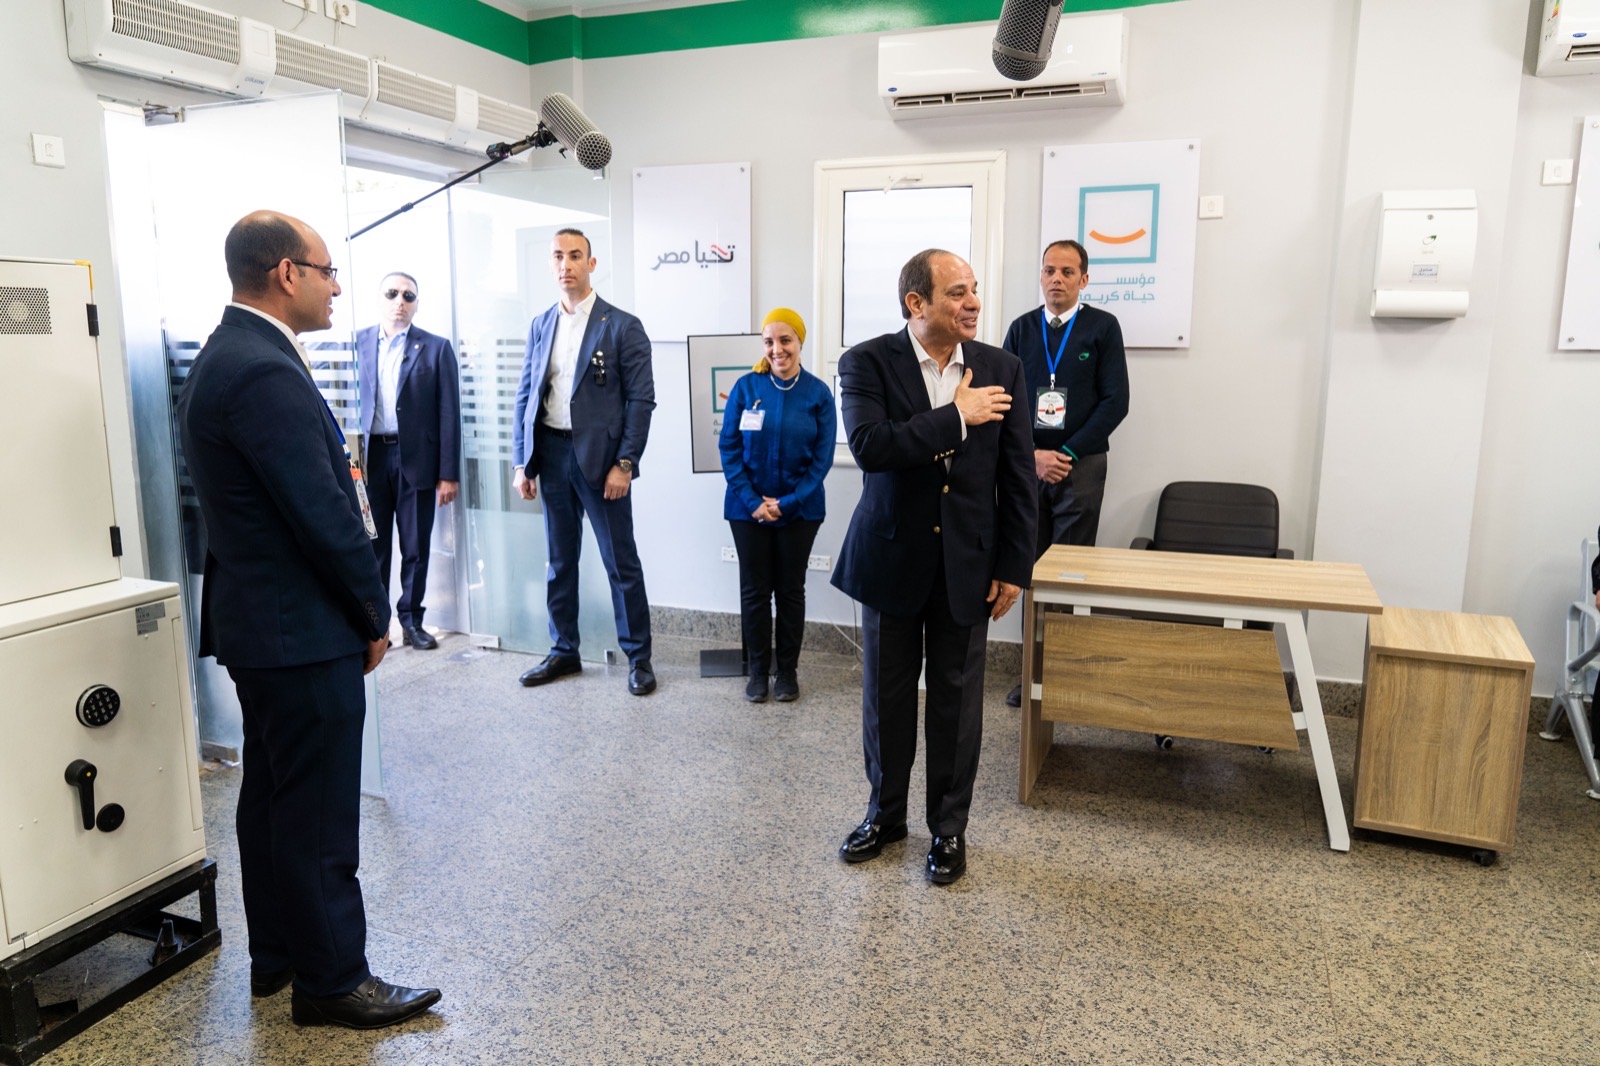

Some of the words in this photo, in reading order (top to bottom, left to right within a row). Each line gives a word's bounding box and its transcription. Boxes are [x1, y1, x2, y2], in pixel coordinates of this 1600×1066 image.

[650, 250, 690, 271] مصر
[694, 239, 736, 268] تحيا
[1087, 273, 1156, 288] مؤسس
[1123, 290, 1155, 304] حياة
